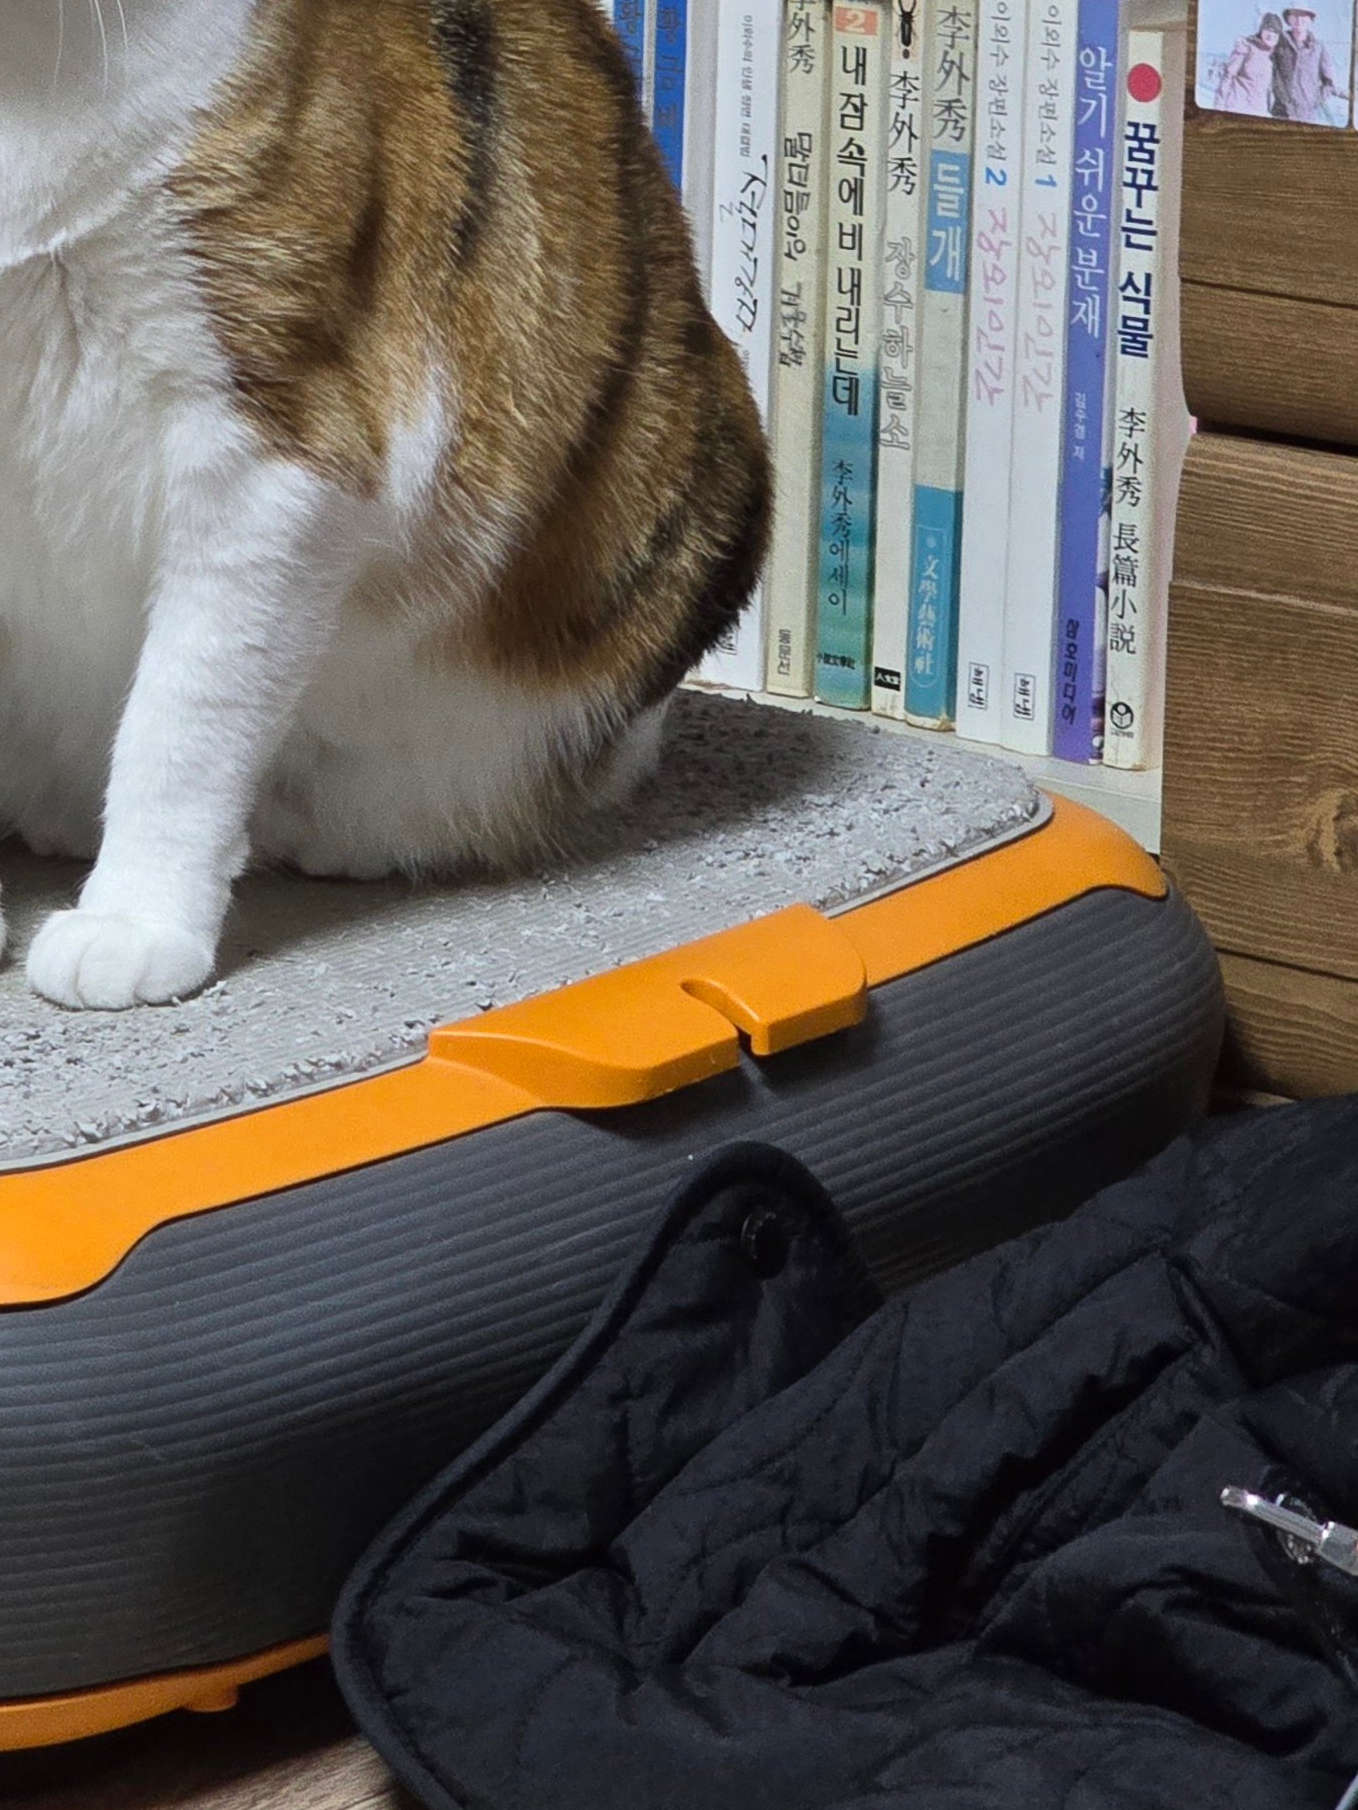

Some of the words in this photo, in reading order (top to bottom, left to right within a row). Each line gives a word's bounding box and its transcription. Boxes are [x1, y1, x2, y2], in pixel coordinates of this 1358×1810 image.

[841, 46, 868, 87] 내
[933, 5, 971, 143] 李外秀
[987, 1, 1012, 67] 이외수
[1037, 3, 1063, 70] 이외수
[838, 92, 869, 132] 잠
[887, 71, 921, 196] 李外秀
[986, 74, 1010, 162] 장편소설
[1034, 76, 1059, 167] 장편소설
[1076, 46, 1113, 140] 알기
[783, 132, 813, 262] 말더듬이의
[836, 138, 869, 217] 속에
[929, 161, 968, 283] 들개
[1072, 146, 1109, 241] 쉬운
[1118, 120, 1161, 252] 꿈꾸는
[718, 153, 769, 333] 절대강자
[837, 223, 864, 260] 비
[832, 268, 863, 417] 내리는데
[879, 238, 916, 451] 장수하늘소
[973, 208, 1008, 408] 장외인간
[1022, 212, 1062, 412] 장외인간
[1068, 252, 1109, 339] 분재
[1116, 270, 1154, 359] 식물
[1115, 407, 1147, 509] 李外秀
[827, 458, 854, 616] 李外秀에세이
